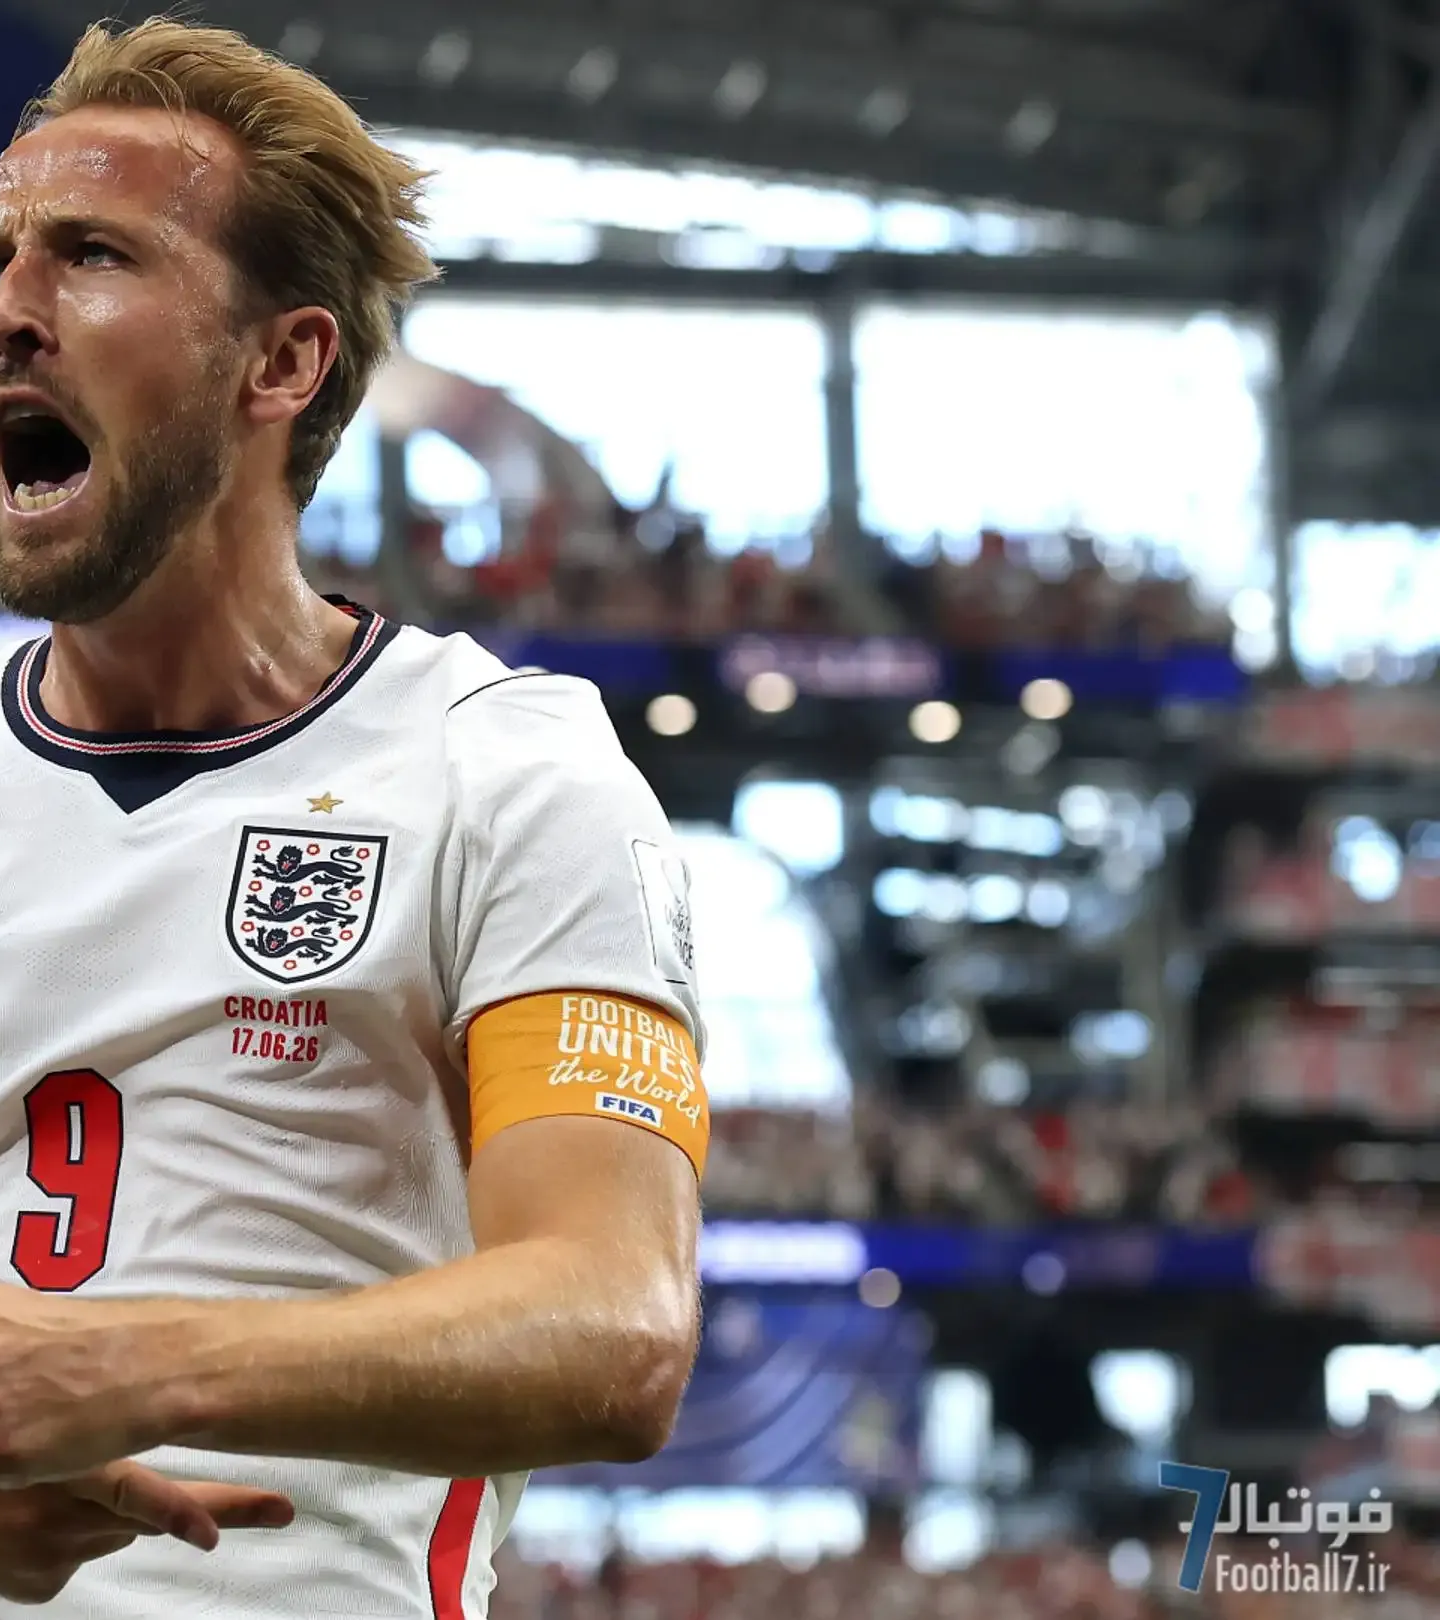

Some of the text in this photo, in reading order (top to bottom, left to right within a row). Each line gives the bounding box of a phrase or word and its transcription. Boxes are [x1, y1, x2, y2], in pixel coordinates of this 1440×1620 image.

[224, 995, 328, 1028] CROATIA
[232, 1027, 318, 1062] 17.06.26
[562, 996, 692, 1064] FOOTBALL
[558, 1021, 696, 1093] UNITES
[545, 1055, 701, 1129] the World
[601, 1096, 657, 1124] FIFA
[10, 1067, 124, 1292] 9
